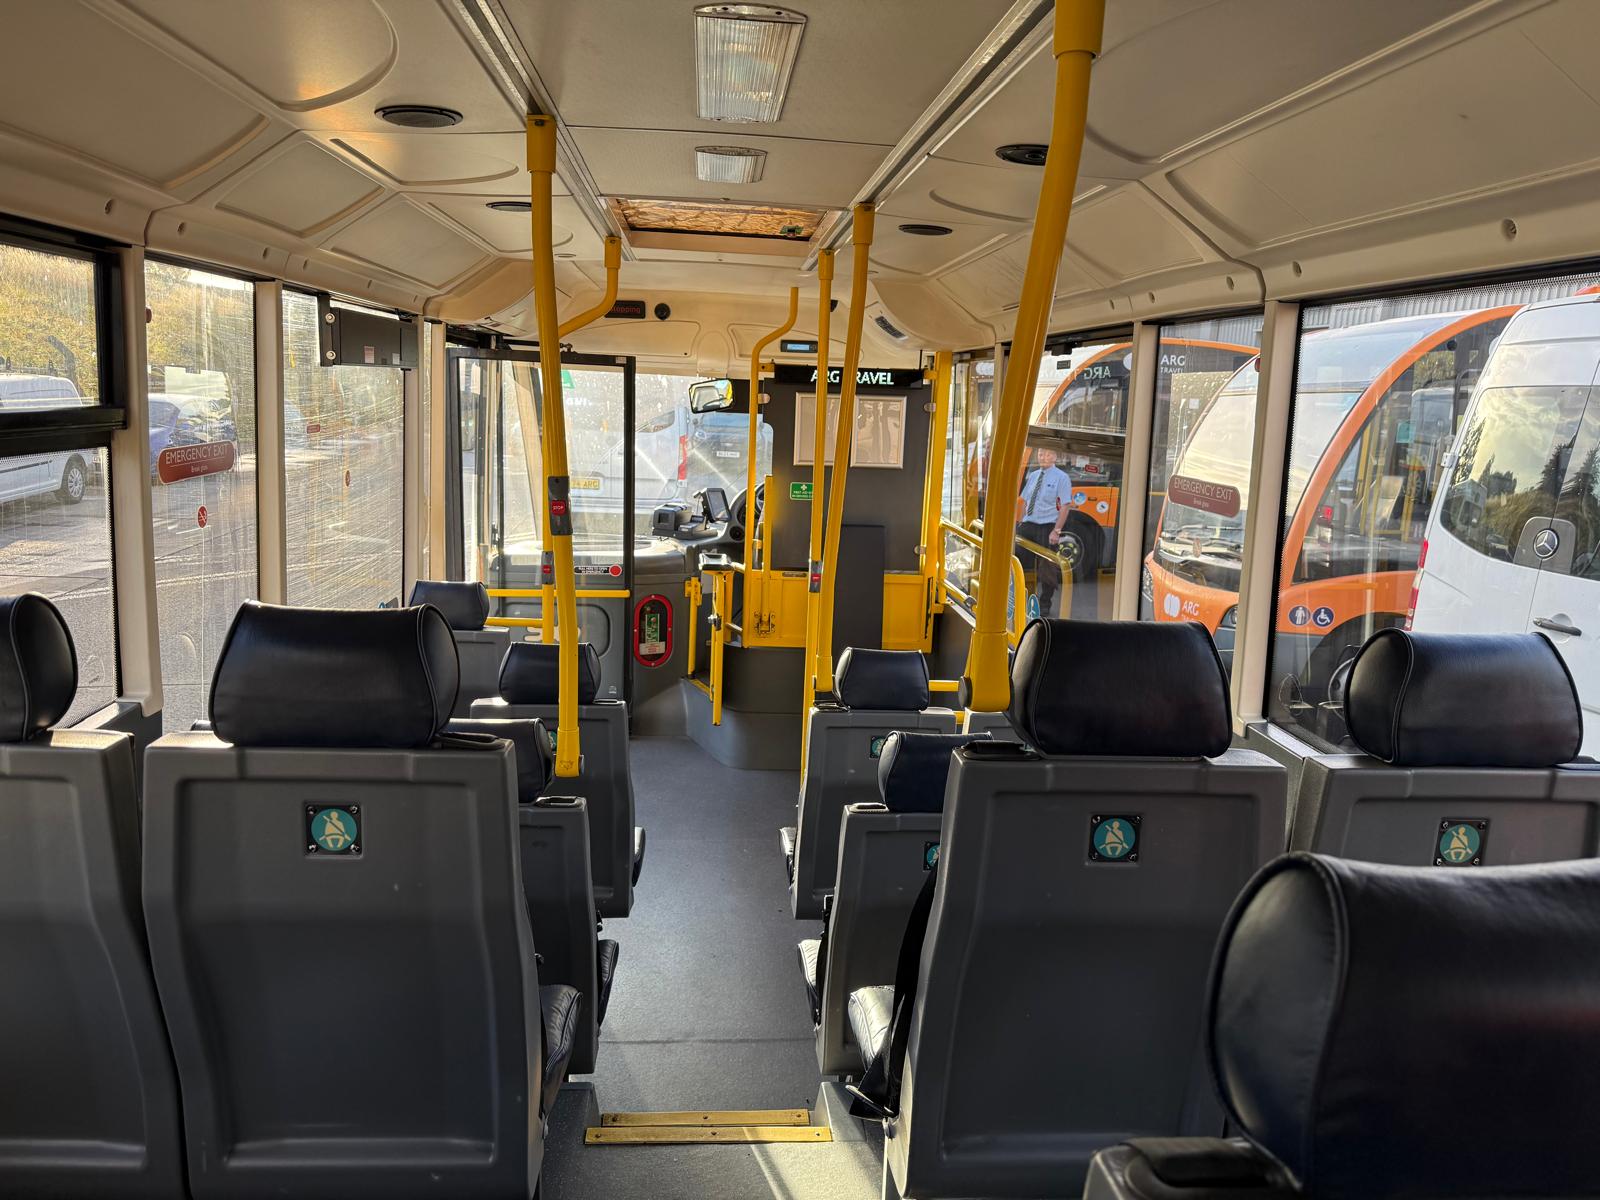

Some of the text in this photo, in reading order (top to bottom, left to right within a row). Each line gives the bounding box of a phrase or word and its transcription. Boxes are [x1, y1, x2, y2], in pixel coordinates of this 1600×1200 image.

[1161, 355, 1185, 365] ARG
[856, 371, 894, 385] RAVEL
[165, 443, 228, 464] EMERGENCY EXIT
[1174, 477, 1233, 501] EMERGENCY EXIT
[1182, 600, 1199, 616] ARG
